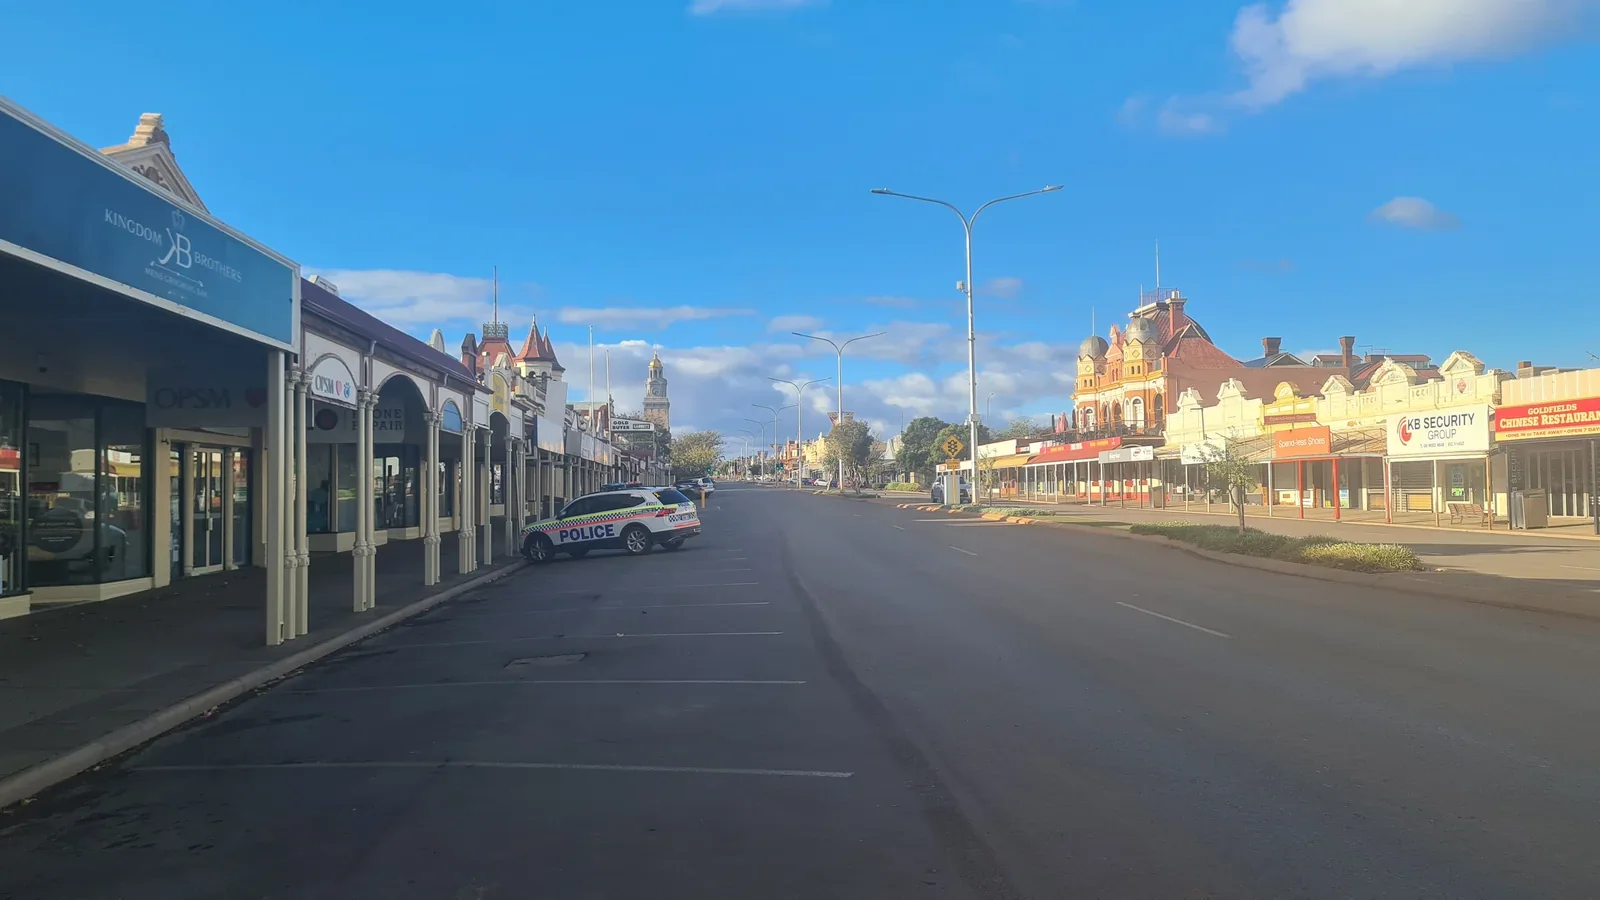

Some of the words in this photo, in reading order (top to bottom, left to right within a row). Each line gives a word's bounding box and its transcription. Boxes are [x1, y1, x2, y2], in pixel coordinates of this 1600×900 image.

[104, 208, 162, 246] KINGDOM
[194, 253, 242, 283] BROTHERS
[315, 375, 334, 394] OPSM
[154, 387, 231, 409] OPSM
[1528, 404, 1577, 415] GOLDFIELDS
[1408, 418, 1420, 430] KB
[1424, 413, 1475, 429] SECURITY
[1500, 416, 1539, 428] CHINESE
[1428, 428, 1456, 440] GROUP
[559, 524, 615, 543] POLICE
